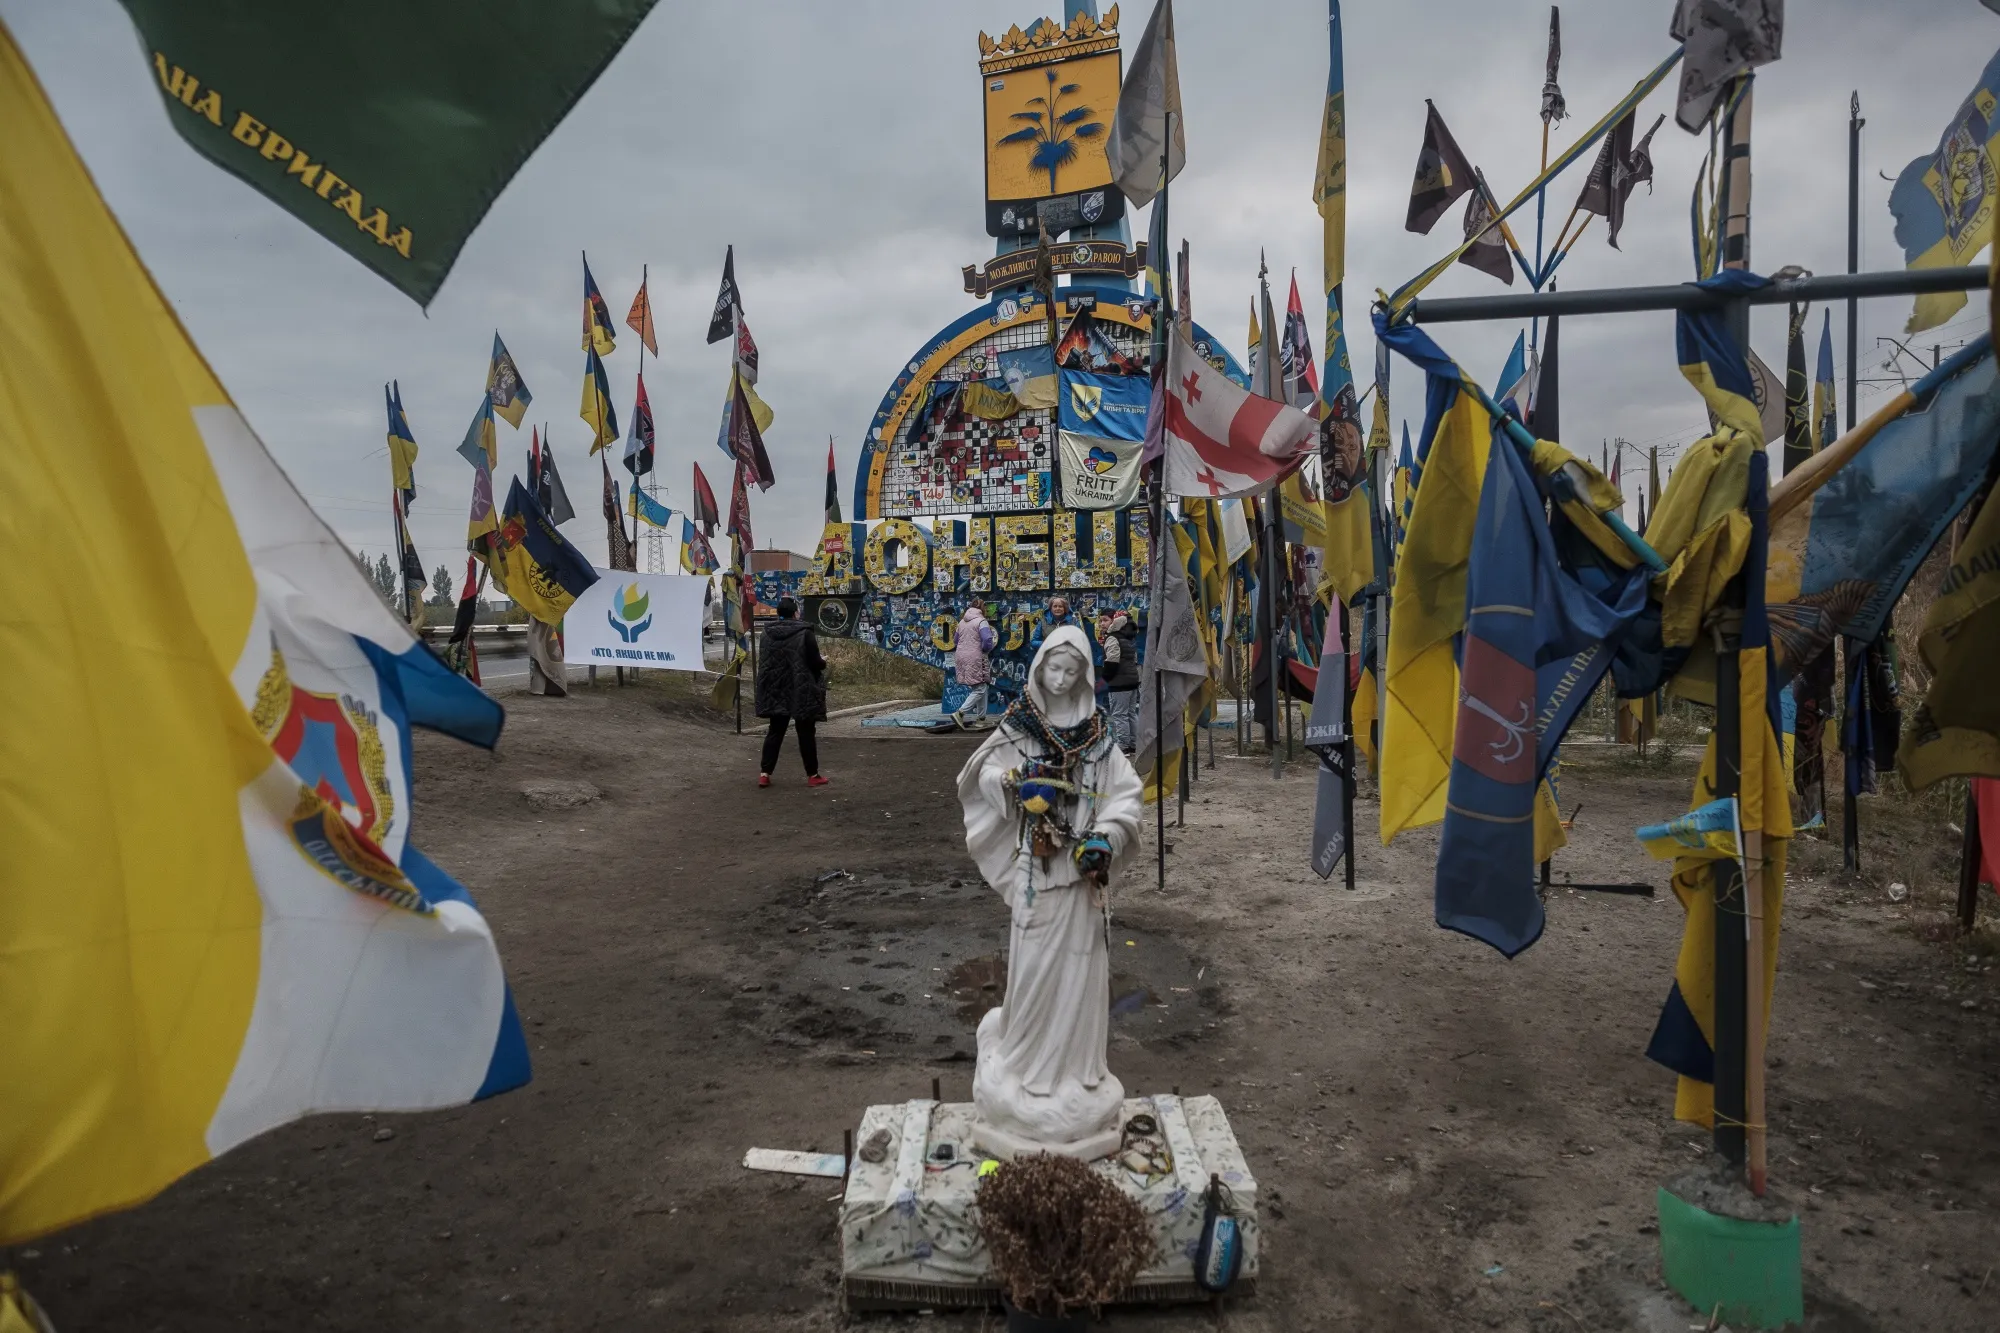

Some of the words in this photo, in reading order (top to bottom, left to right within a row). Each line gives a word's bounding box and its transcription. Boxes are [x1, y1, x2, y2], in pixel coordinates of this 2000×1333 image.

[230, 110, 413, 259] БРИГАДА
[989, 259, 1038, 281] МОЖЛИВІСТ
[1091, 252, 1121, 264] РАВОЮ
[1032, 473, 1040, 503] VIRTUS
[1077, 475, 1117, 491] FRITT
[921, 487, 944, 501] T4U
[1075, 488, 1115, 502] UKRAINA
[616, 648, 643, 661] ЯКЩО
[644, 650, 656, 660] НЕ
